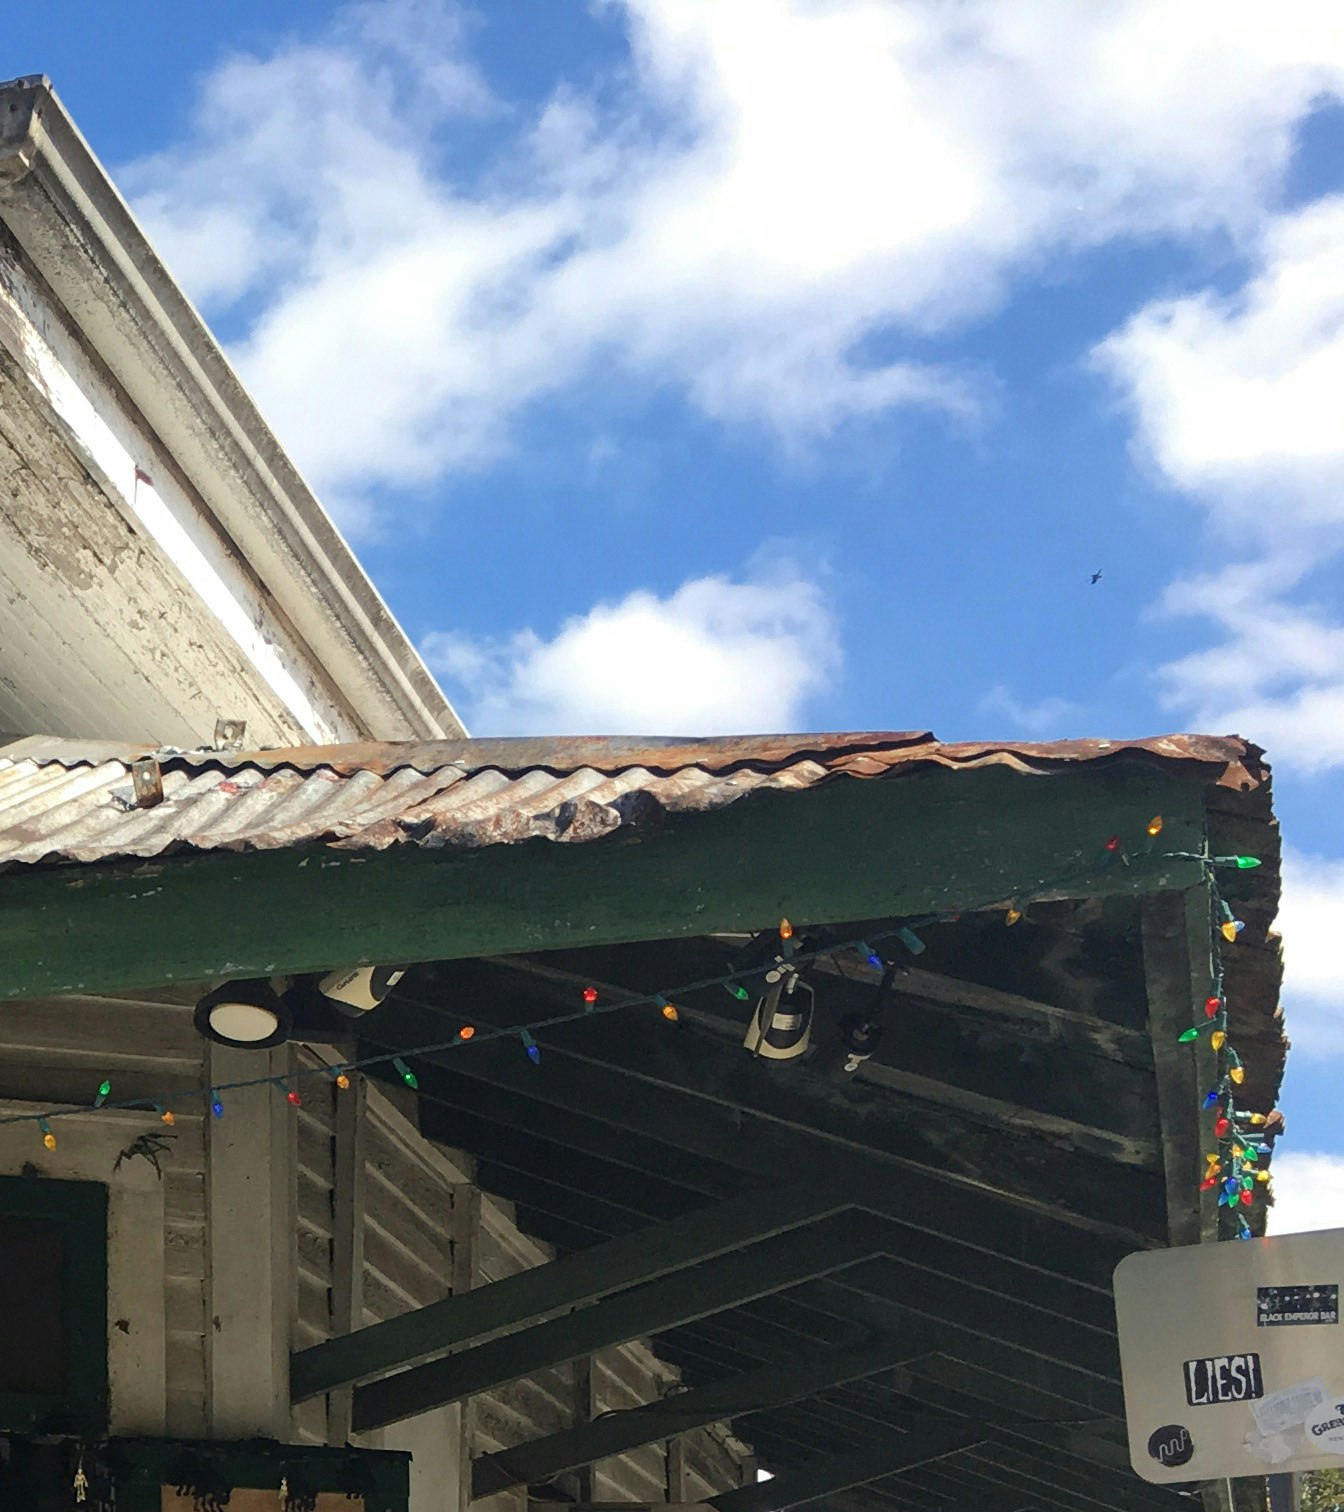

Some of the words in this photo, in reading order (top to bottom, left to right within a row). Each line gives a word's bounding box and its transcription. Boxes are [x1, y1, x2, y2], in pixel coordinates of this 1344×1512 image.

[1260, 1313, 1282, 1322] BLACK
[1284, 1312, 1319, 1321] EMPEROR
[1320, 1311, 1337, 1320] BAR
[1188, 1355, 1256, 1404] LIES!
